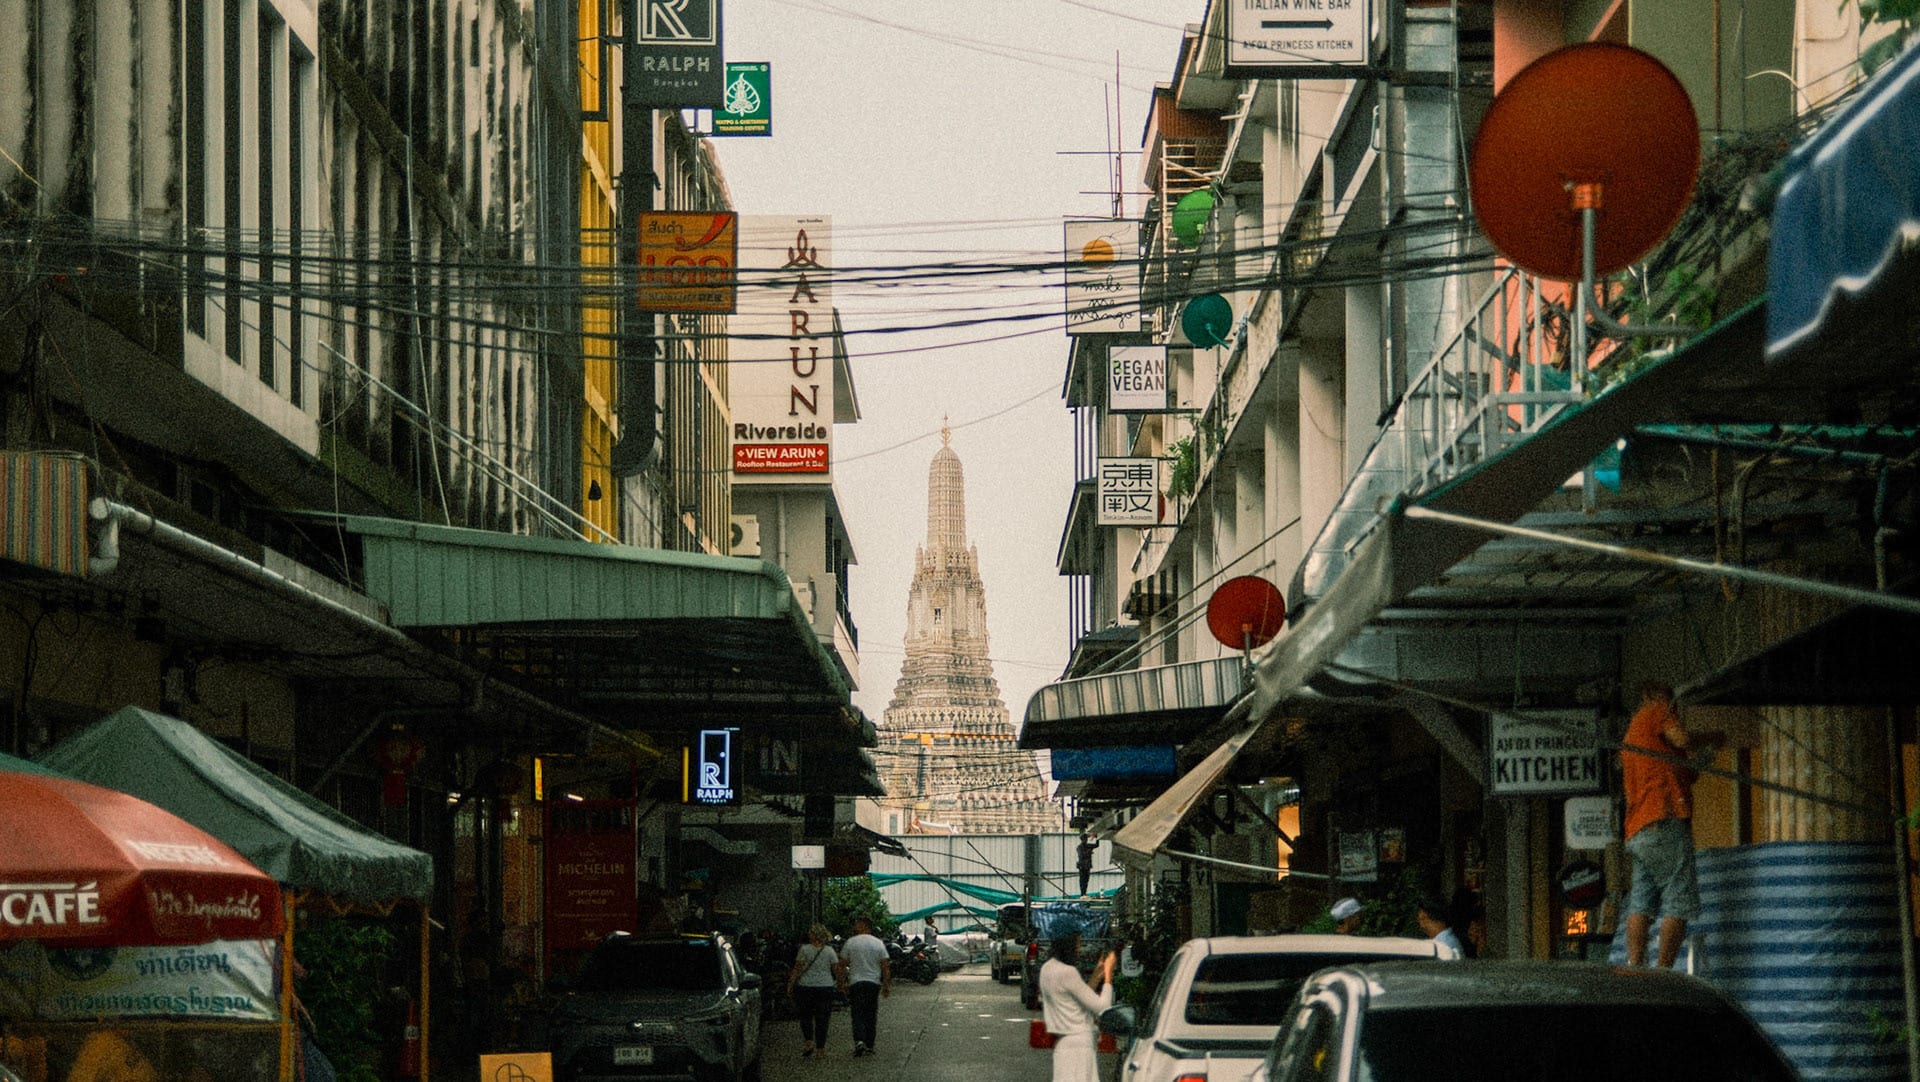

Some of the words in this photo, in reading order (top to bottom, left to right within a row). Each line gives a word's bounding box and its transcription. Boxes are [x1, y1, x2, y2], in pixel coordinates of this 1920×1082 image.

[1244, 0, 1289, 10] ITALIAN
[1293, 0, 1323, 10] WINE
[1328, 0, 1351, 10] BAR
[1270, 40, 1313, 50] PRINCESS
[1317, 40, 1353, 50] KITCHEN
[643, 56, 711, 73] RALPH
[788, 271, 819, 416] ARUN
[1112, 360, 1165, 375] BEGAN
[1113, 375, 1165, 391] VEGAN
[734, 422, 827, 440] Riverside
[745, 448, 778, 459] VIEW
[780, 448, 816, 458] ARUN
[1496, 756, 1598, 783] KITCHEN
[696, 788, 734, 800] RALPH
[0, 880, 100, 925] CAFÉ
